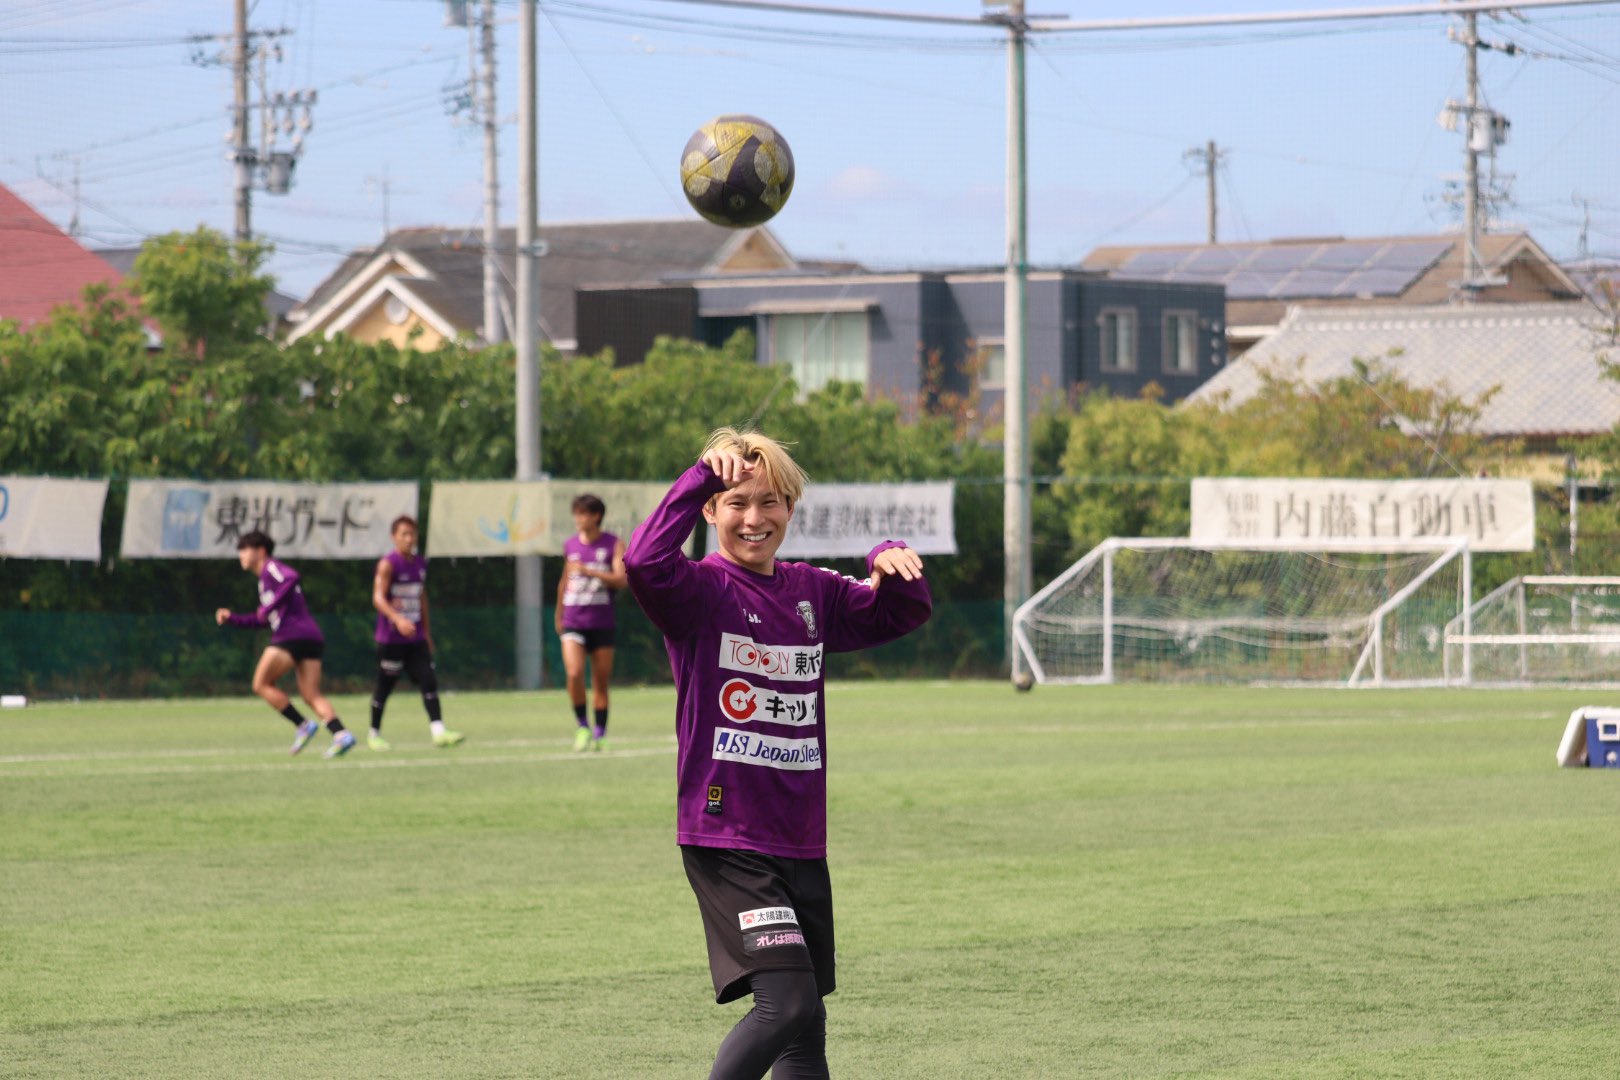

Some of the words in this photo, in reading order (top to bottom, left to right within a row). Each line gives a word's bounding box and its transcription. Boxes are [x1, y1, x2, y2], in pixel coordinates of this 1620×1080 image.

[757, 910, 796, 922] 太陽建機レ
